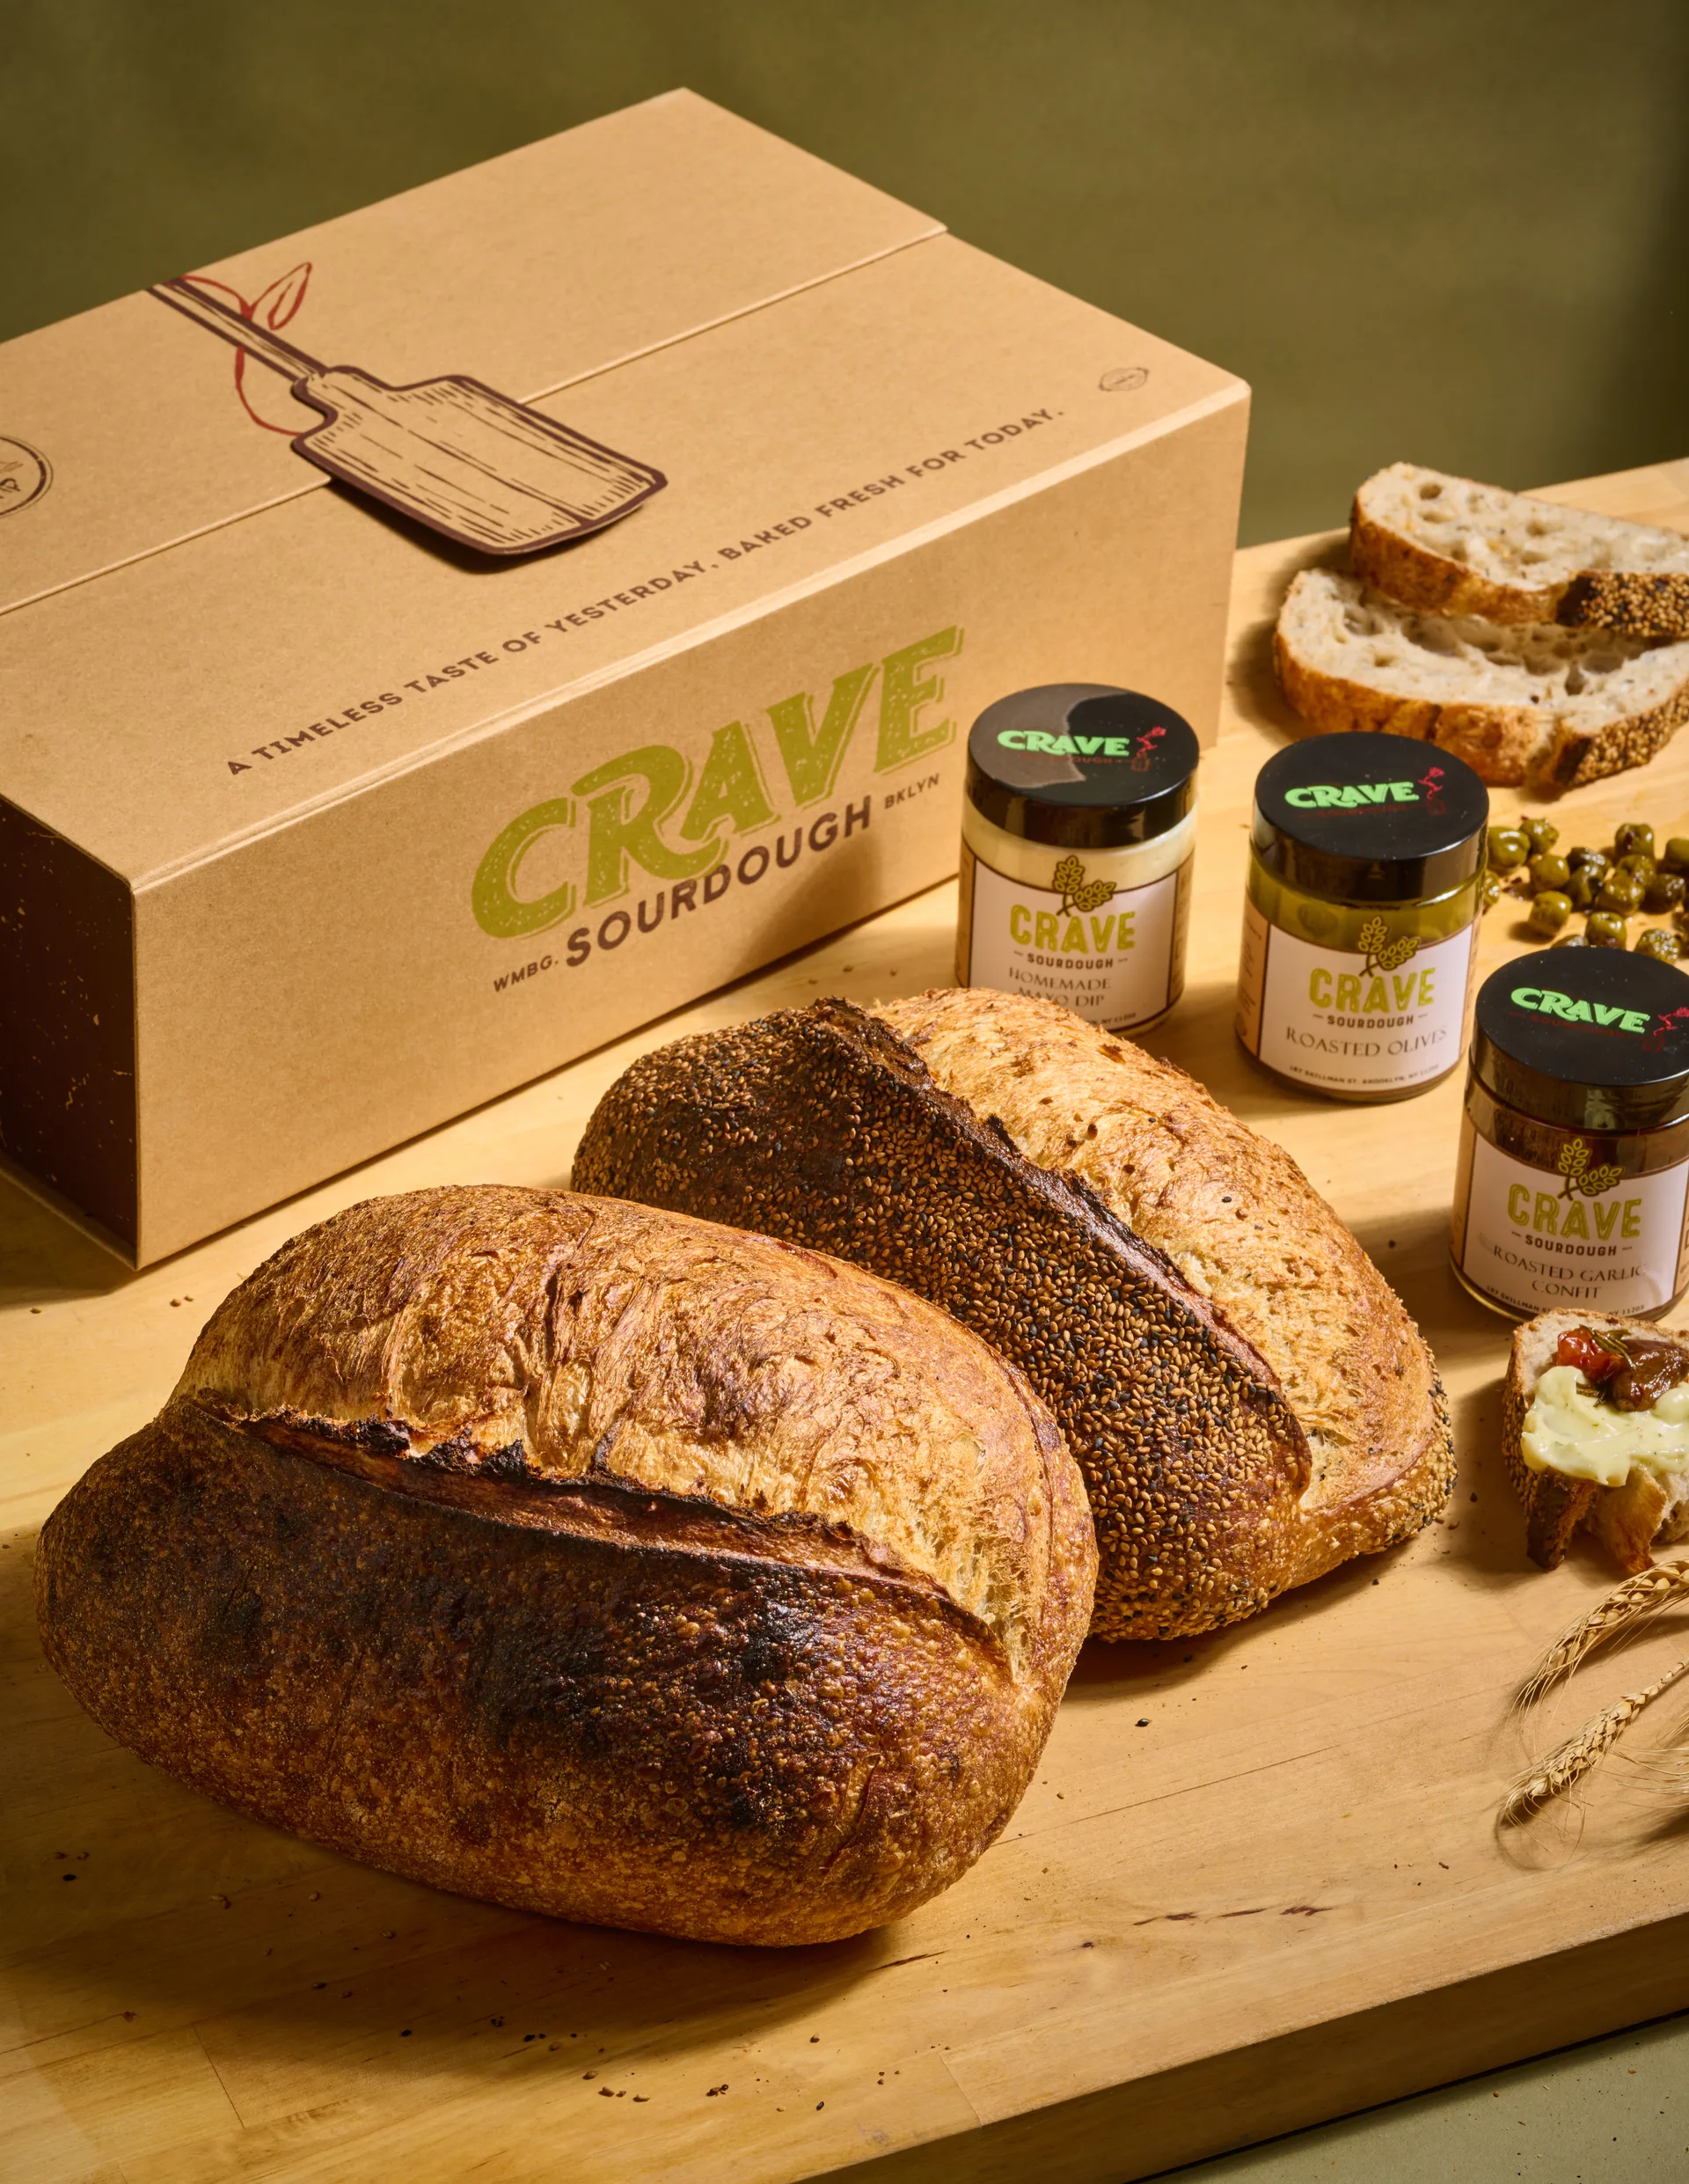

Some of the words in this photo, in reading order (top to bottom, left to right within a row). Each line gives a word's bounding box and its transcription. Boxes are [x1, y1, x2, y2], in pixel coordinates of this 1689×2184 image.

[227, 760, 252, 775] A
[251, 693, 403, 761] TIMELESS
[403, 650, 499, 693] TASTE
[501, 630, 543, 653] OF
[717, 515, 813, 561] BAKED
[815, 475, 906, 518] FRESH
[906, 449, 966, 478] FOR
[964, 407, 1066, 452] TODAY.
[997, 729, 1130, 757] CRAVE
[471, 624, 965, 940] CRAVE
[1284, 781, 1420, 809] CRAVE
[492, 956, 559, 993] WMBG.
[566, 795, 873, 967] SOURDOUGH
[883, 773, 940, 810] BKLYN
[1010, 904, 1136, 955] CRAVE
[1027, 953, 1114, 970] SOURDOUGH
[1009, 966, 1111, 991] HOMEMADE
[1308, 967, 1437, 1015] CRAVE
[1075, 995, 1105, 1008] DIP
[1510, 987, 1651, 1034] CRAVE
[1327, 1014, 1415, 1030] SOURDOUGH
[1285, 1026, 1381, 1057] ROASTED
[1386, 1026, 1449, 1056] OLIVES
[1508, 1183, 1641, 1242] CRAVE
[1525, 1235, 1617, 1257] SOURDOUGH
[1494, 1245, 1574, 1280] ROASTED
[1580, 1264, 1647, 1282] GARLIC
[1501, 1292, 1539, 1312] SKILLMAN
[1532, 1280, 1601, 1299] CONFIT
[1621, 1304, 1645, 1315] 11205
